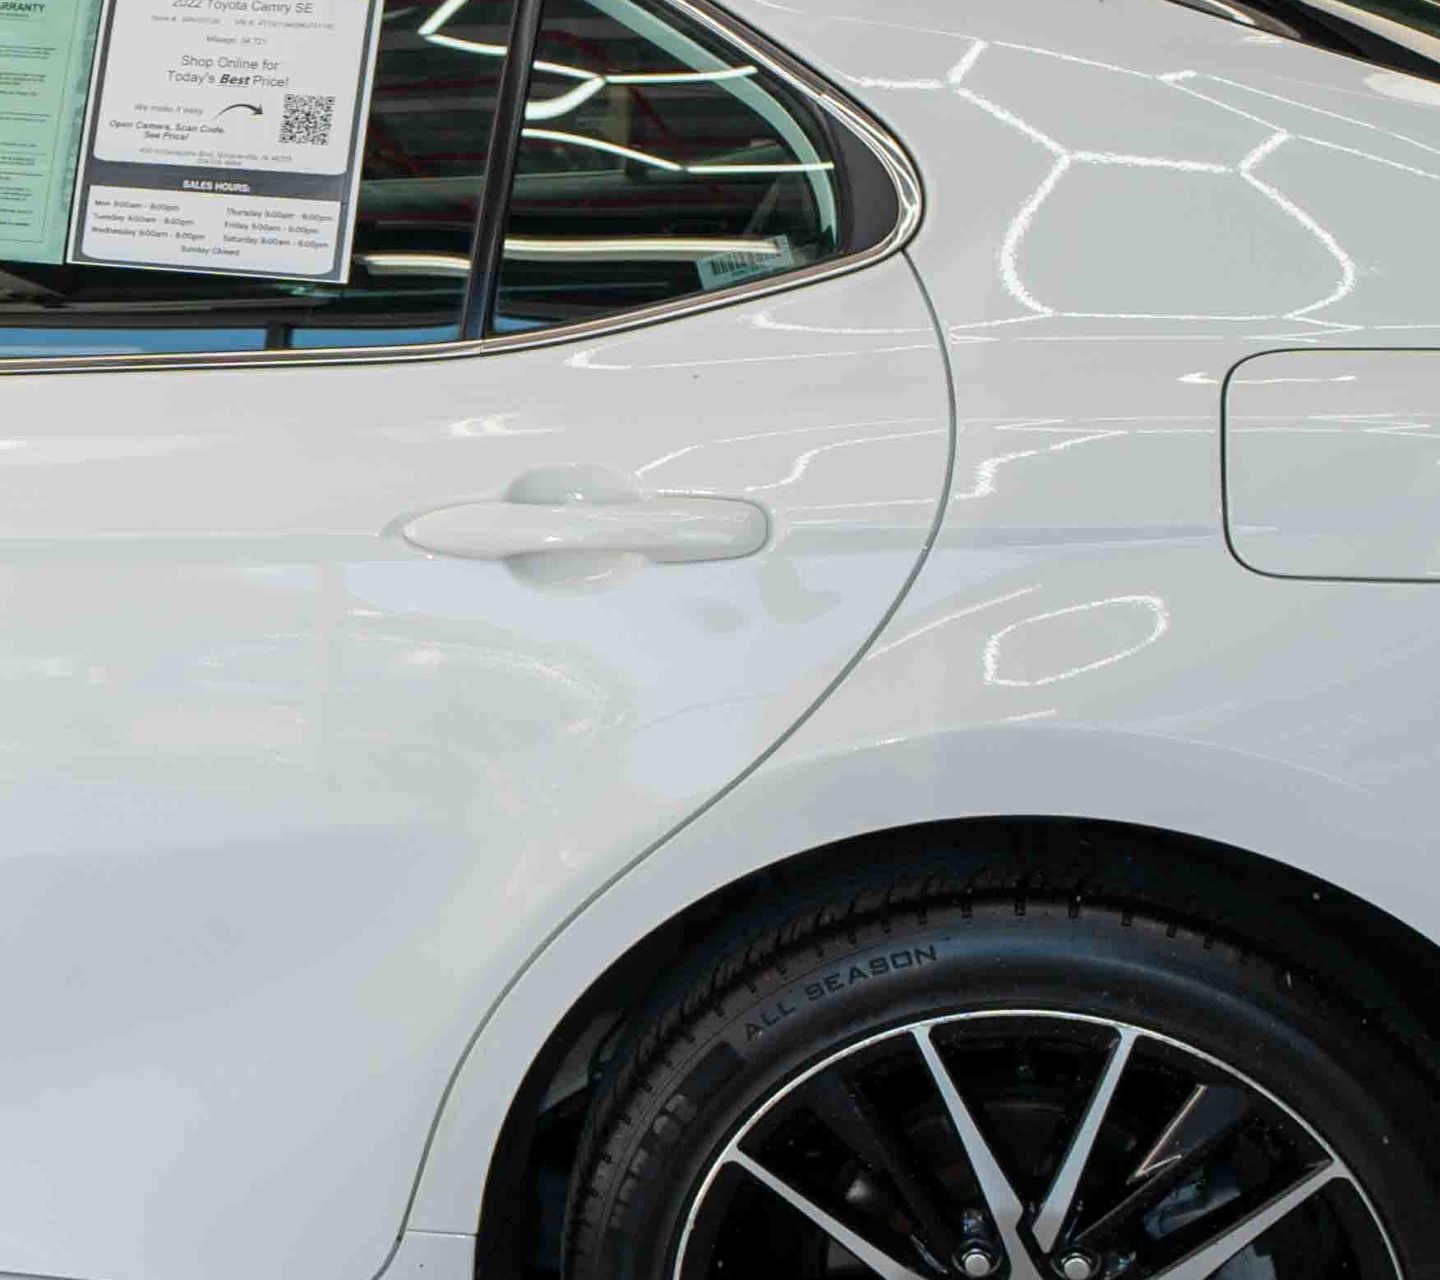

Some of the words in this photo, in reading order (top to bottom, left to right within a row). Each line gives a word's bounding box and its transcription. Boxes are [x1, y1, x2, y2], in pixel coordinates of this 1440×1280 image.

[252, 0, 292, 15] Camry
[295, 2, 314, 14] SE
[182, 55, 213, 69] Shop
[218, 57, 259, 70] Online
[262, 59, 281, 71] for
[168, 70, 215, 85] Today's
[220, 73, 251, 86] Best
[252, 76, 290, 88] Price!
[109, 120, 133, 129] Open
[175, 123, 198, 132] Scan
[144, 130, 161, 139] See
[182, 178, 213, 191] SALES
[742, 1002, 796, 1041] ALL
[804, 943, 938, 1001] SEASON
